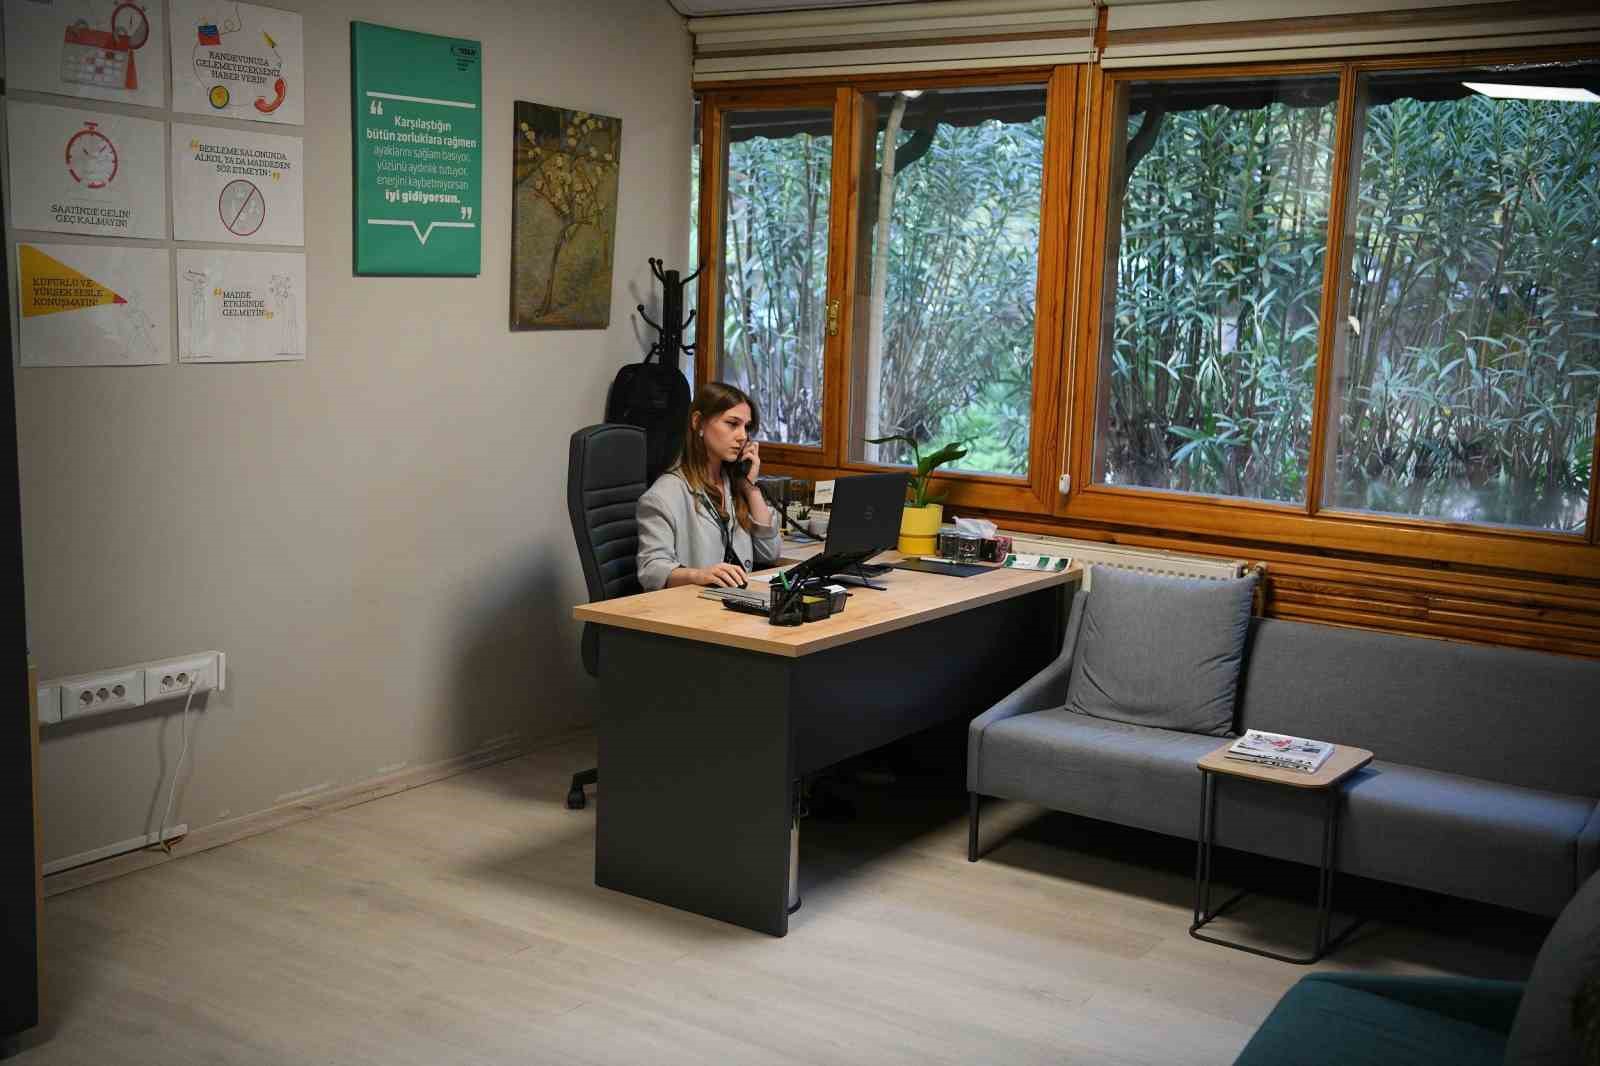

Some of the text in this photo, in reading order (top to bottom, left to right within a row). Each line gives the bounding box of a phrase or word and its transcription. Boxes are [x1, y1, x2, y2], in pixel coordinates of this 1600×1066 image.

[394, 115, 452, 133] Karşılaştığın
[366, 128, 395, 141] bütün
[397, 131, 442, 146] zorluklara
[385, 189, 461, 204] iyi gidiyorsun.
[223, 291, 252, 299] MADDE
